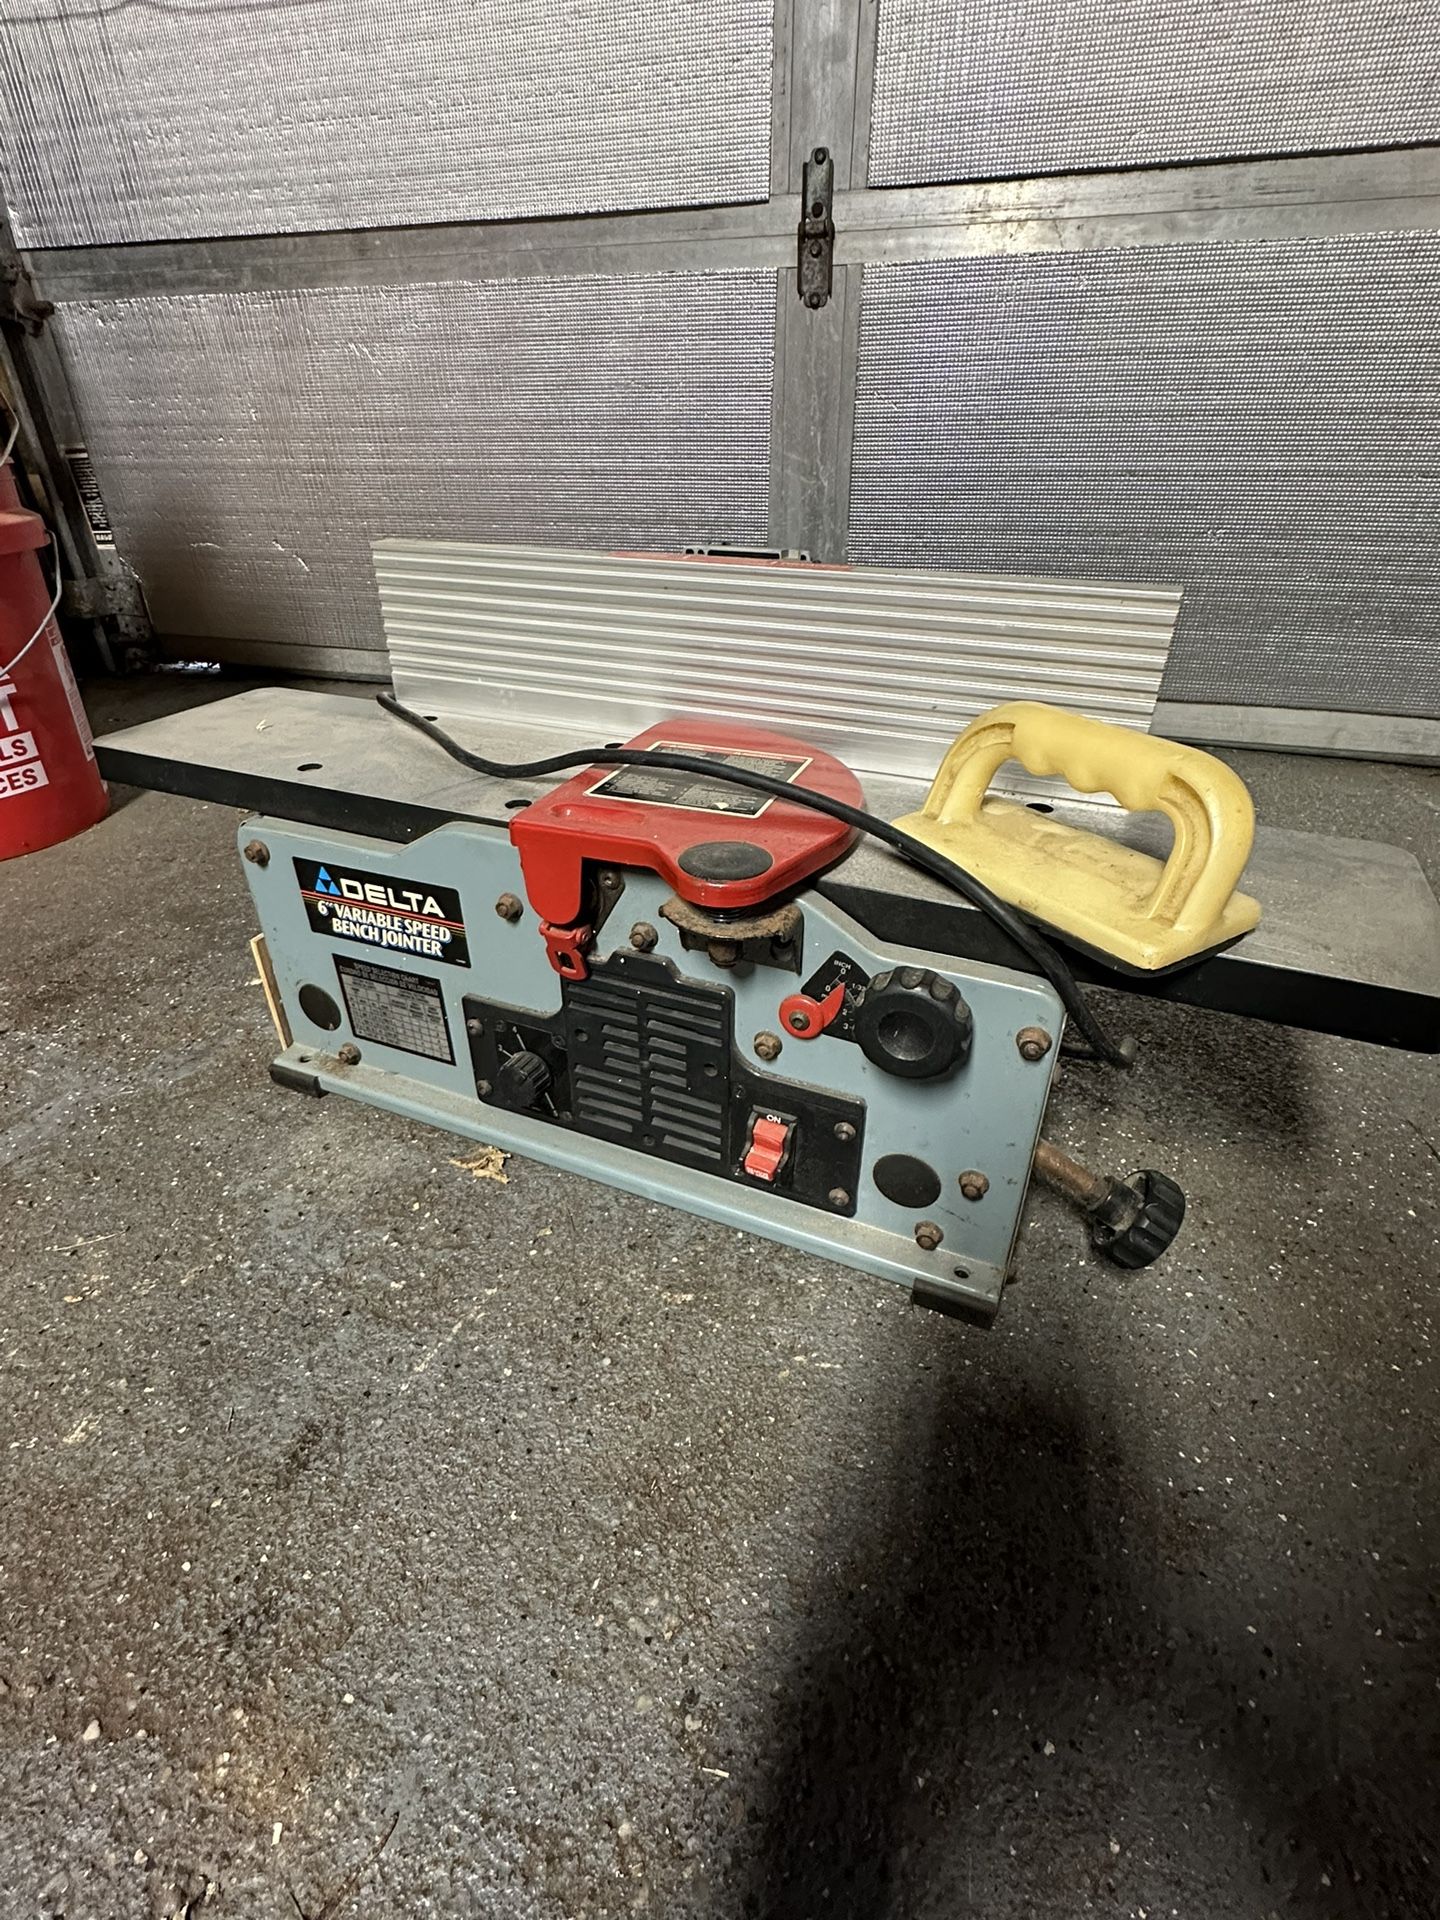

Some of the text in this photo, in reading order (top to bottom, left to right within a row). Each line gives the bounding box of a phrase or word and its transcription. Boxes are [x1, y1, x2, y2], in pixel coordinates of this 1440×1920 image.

[340, 878, 446, 918] DELTA
[334, 904, 404, 932] VARIABLE
[403, 918, 452, 944] SPEED
[332, 917, 444, 957] BENCH JOINTER
[834, 960, 852, 970] INCH
[840, 967, 847, 975] 0
[825, 984, 831, 992] 0
[842, 1008, 848, 1016] 2
[842, 1022, 849, 1030] 3
[766, 1114, 782, 1124] ON
